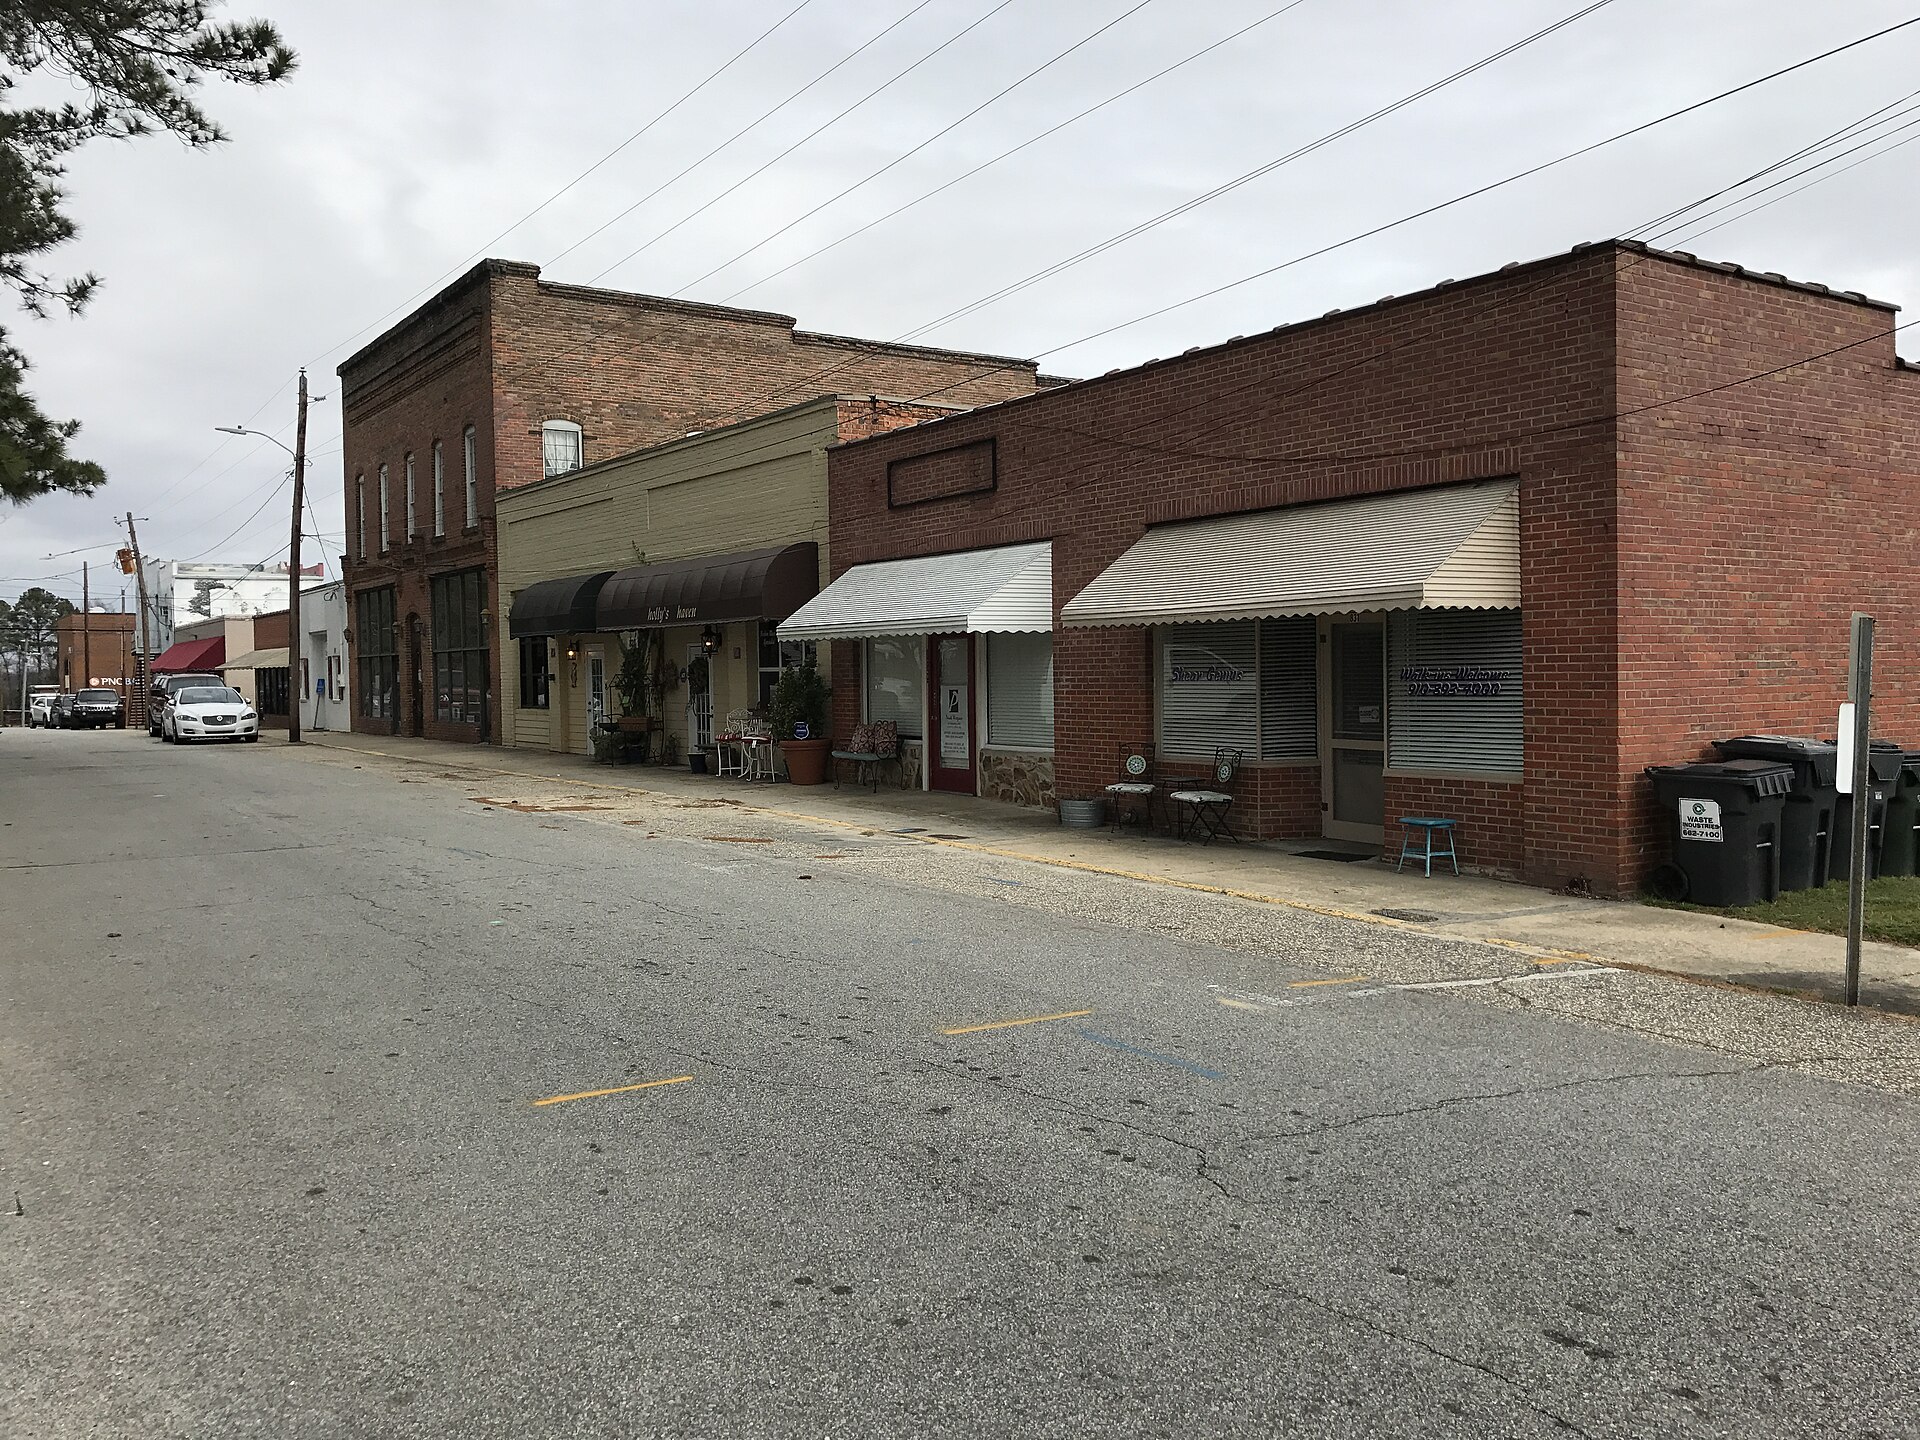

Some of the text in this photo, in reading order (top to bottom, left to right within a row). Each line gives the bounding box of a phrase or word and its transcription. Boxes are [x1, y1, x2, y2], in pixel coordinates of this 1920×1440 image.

[1171, 664, 1244, 682] Shear Genius
[100, 677, 123, 686] PNC
